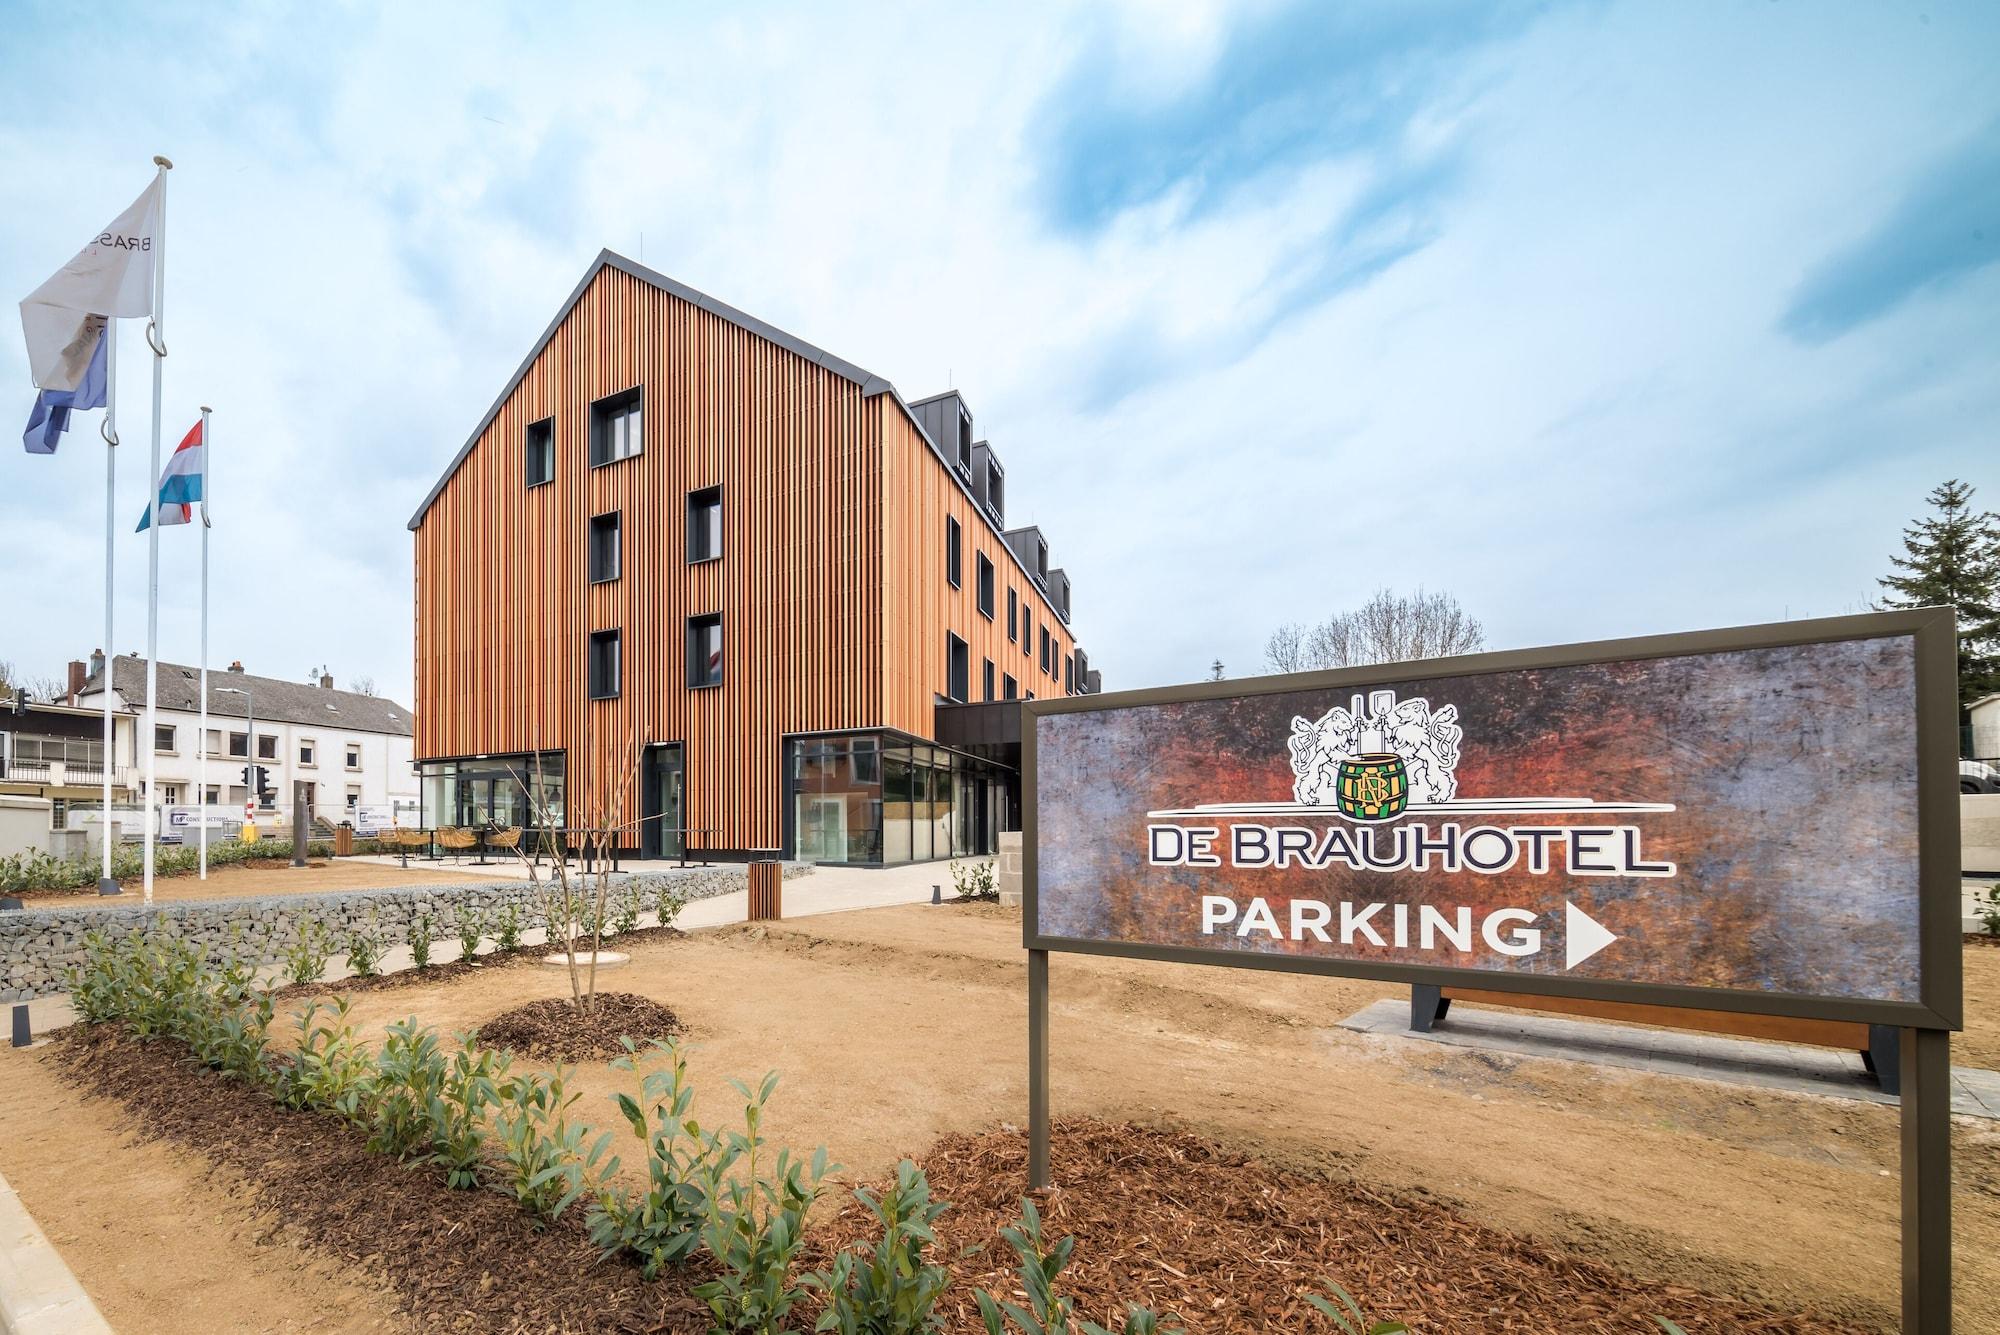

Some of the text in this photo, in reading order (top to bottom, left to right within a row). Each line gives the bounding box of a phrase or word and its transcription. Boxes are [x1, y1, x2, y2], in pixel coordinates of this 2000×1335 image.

[1150, 827, 1671, 873] DE BRAUHOTEL
[1202, 897, 1541, 956] PARKING
